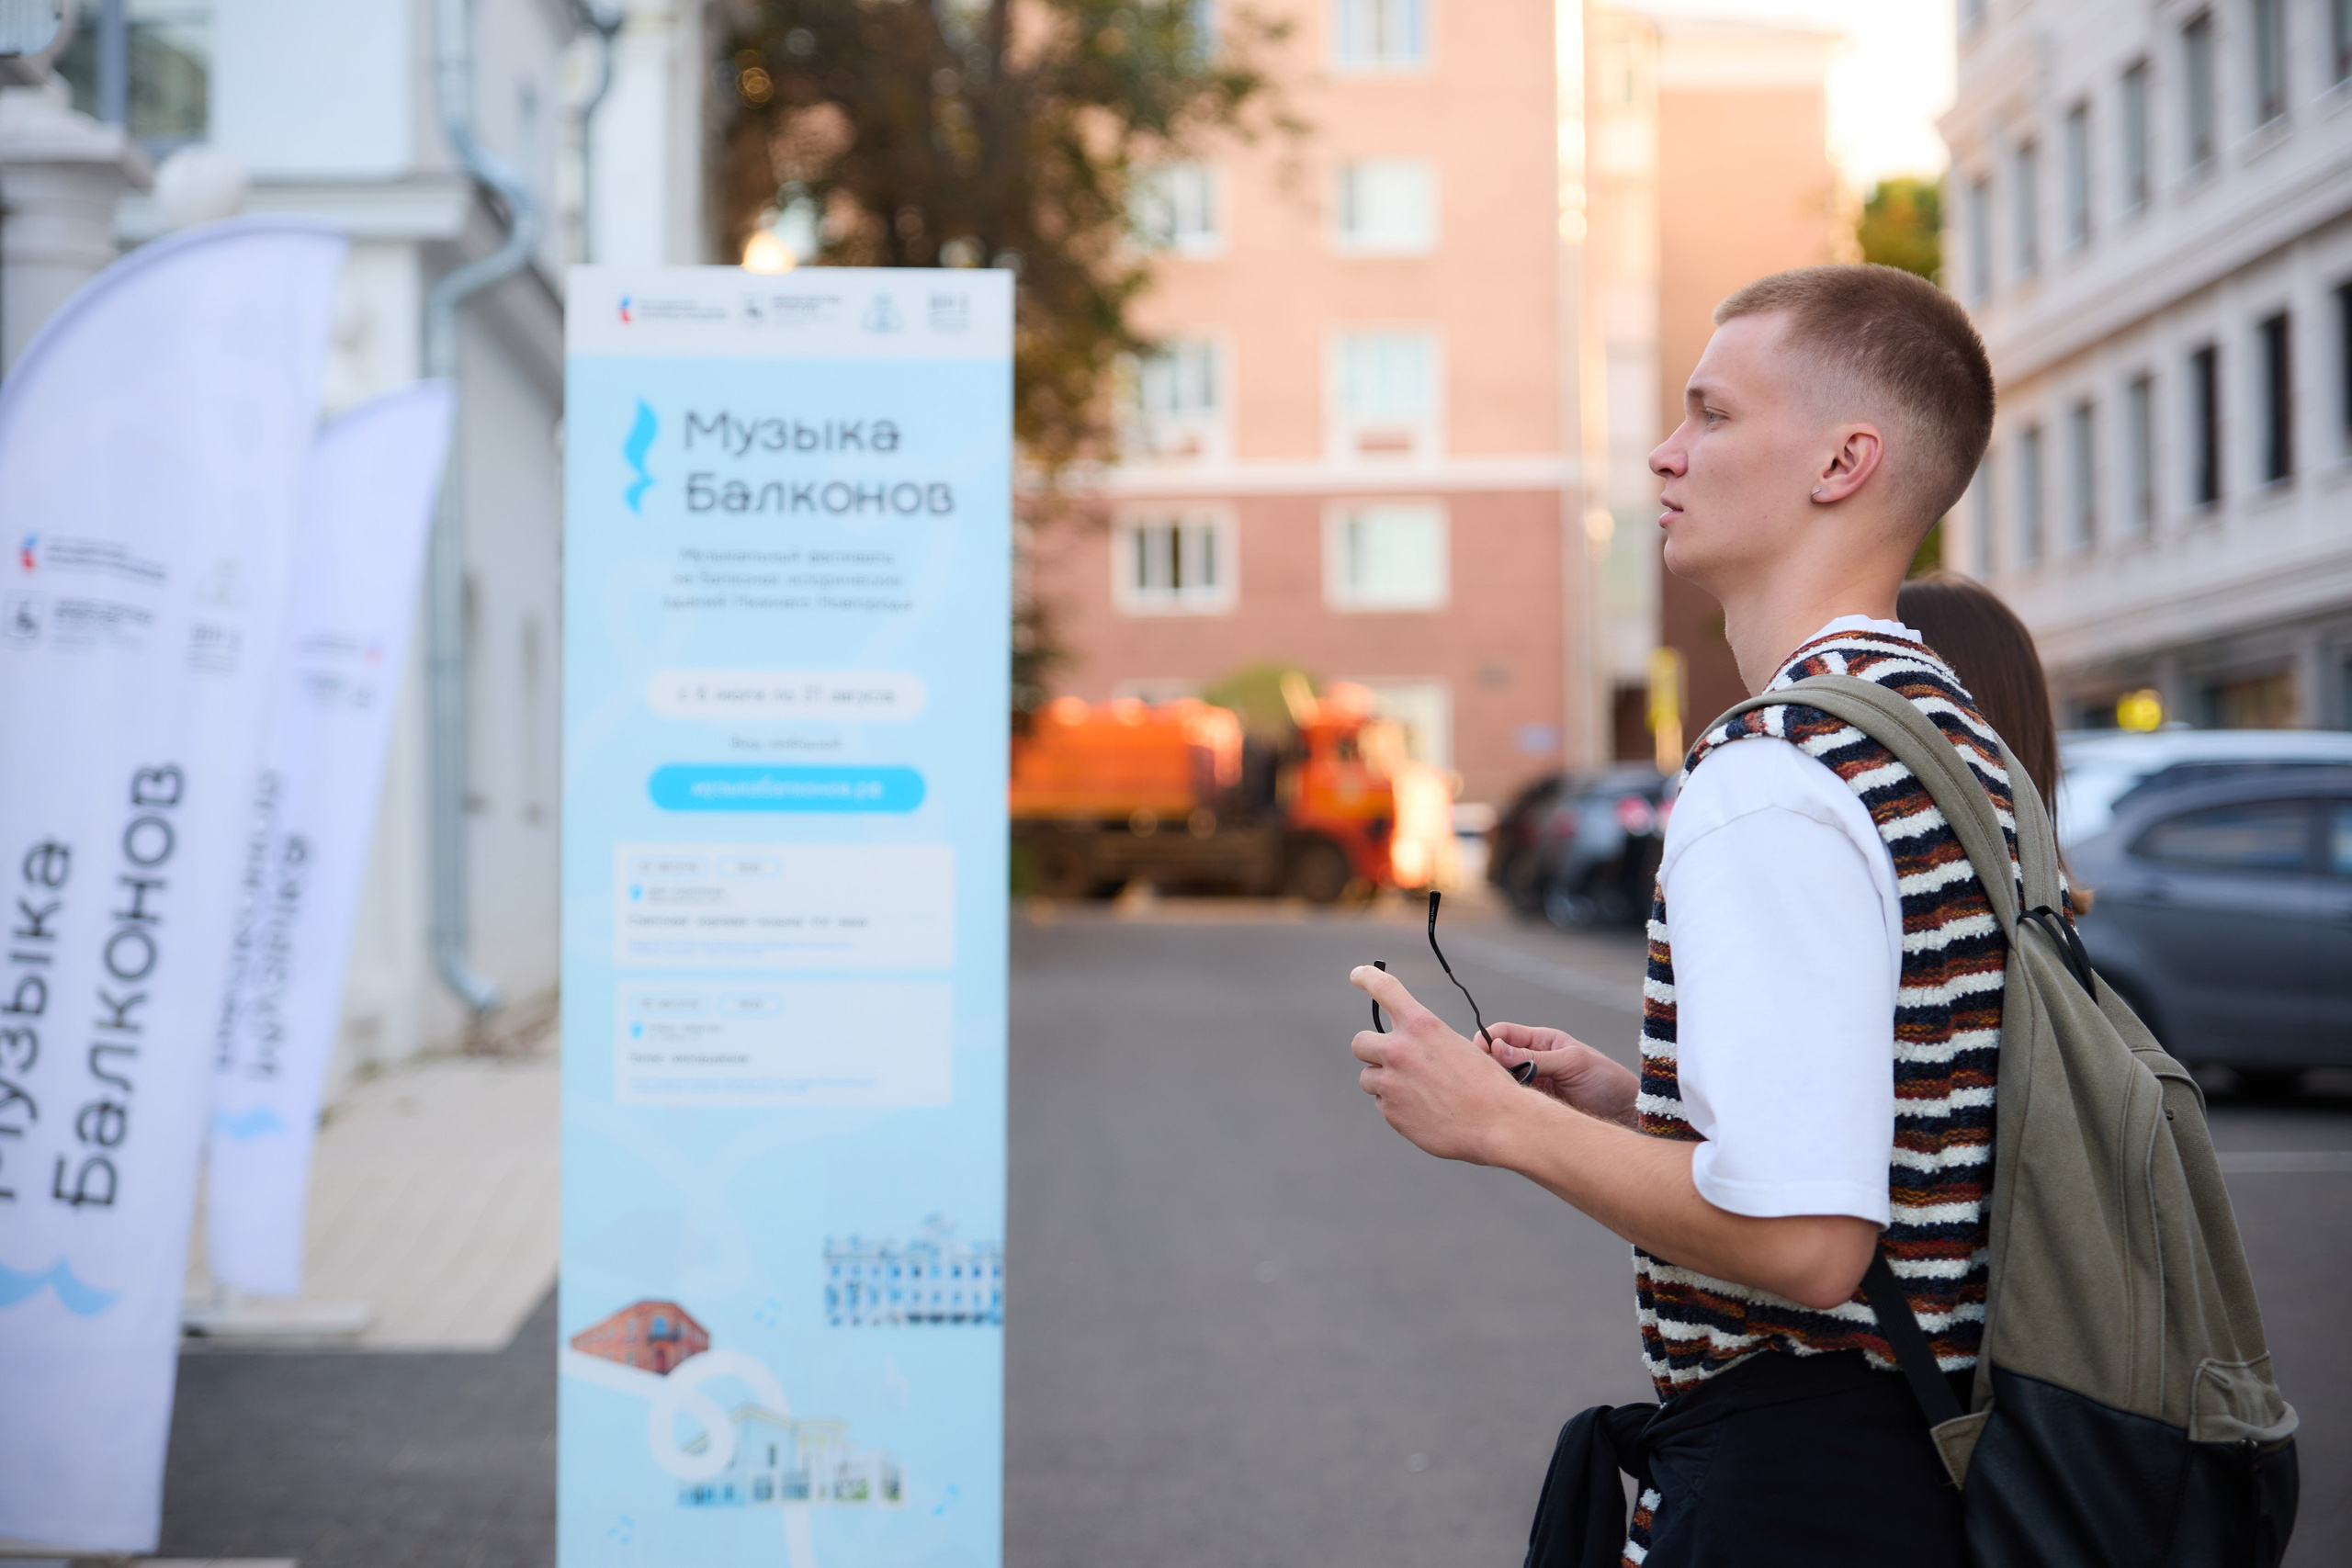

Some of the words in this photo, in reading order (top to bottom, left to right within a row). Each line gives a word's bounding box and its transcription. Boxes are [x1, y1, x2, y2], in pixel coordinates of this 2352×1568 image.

[684, 410, 902, 457] Музыка
[684, 472, 956, 516] Балконов
[51, 764, 187, 1213] Балконов
